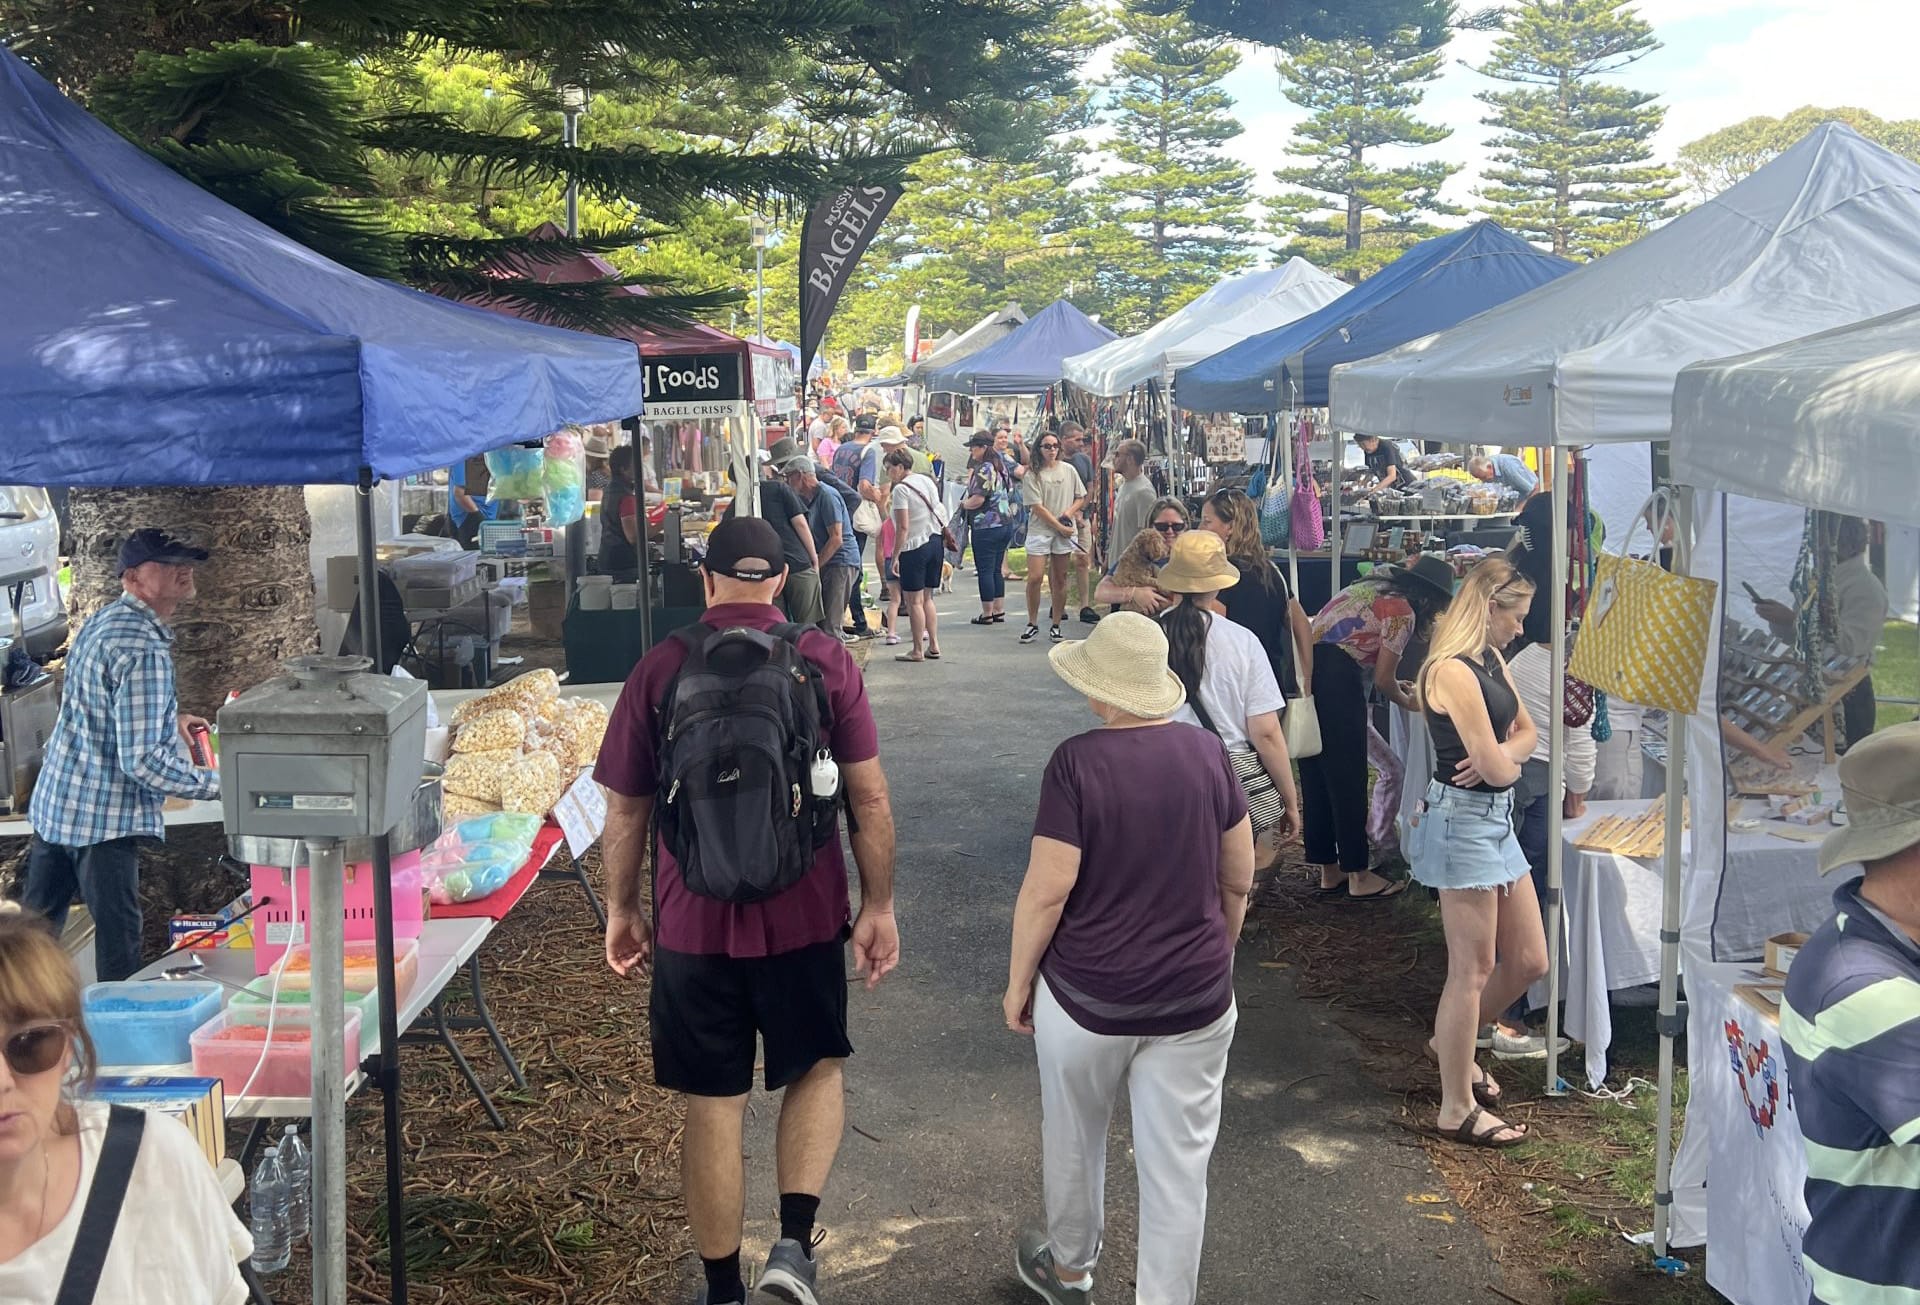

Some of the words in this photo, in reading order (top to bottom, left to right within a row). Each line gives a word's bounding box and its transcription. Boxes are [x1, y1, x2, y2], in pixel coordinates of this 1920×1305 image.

[808, 185, 887, 297] BAGELS
[653, 406, 690, 416] BAGEL
[693, 405, 733, 414] CRISPS
